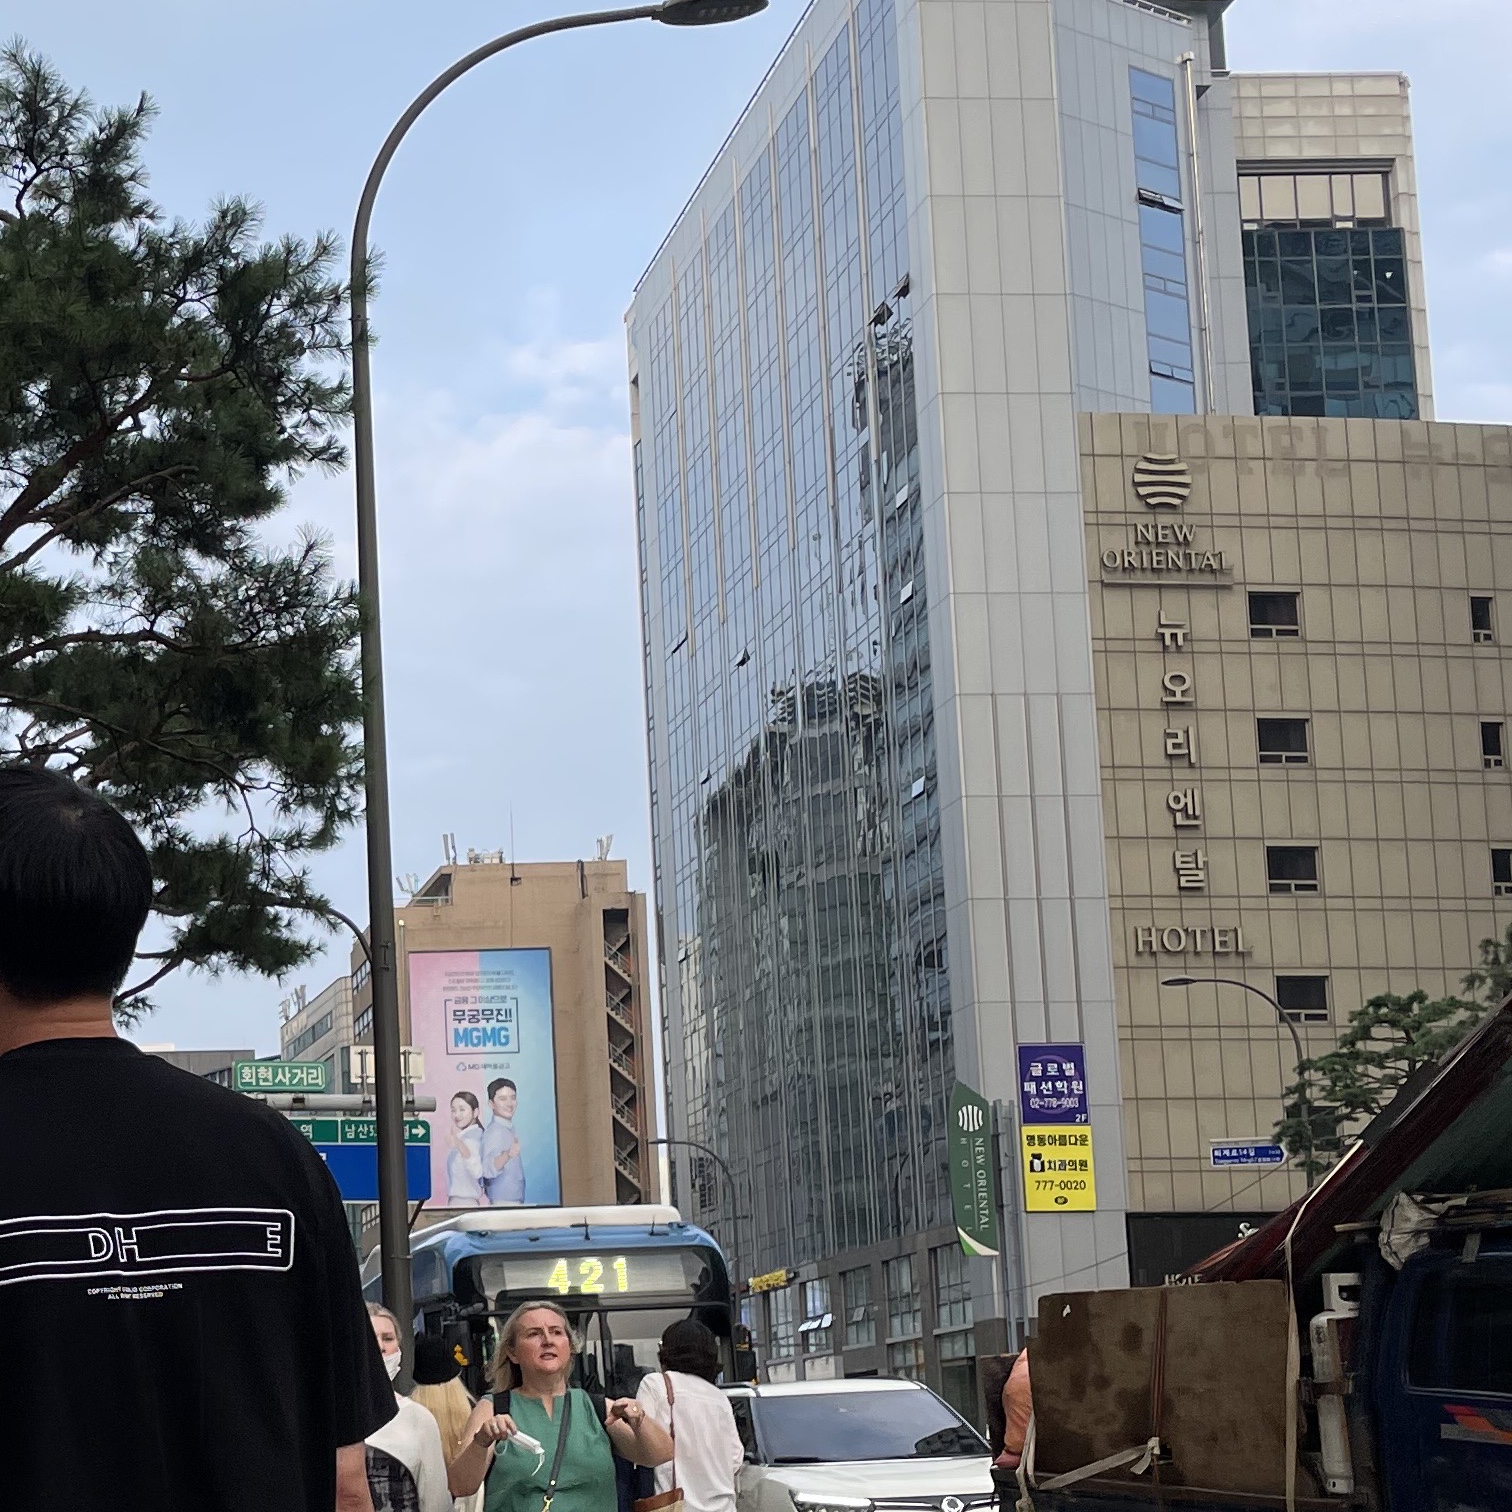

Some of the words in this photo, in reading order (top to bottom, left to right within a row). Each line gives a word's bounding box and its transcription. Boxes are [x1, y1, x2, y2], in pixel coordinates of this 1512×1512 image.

[1133, 523, 1197, 545] NEW
[1101, 549, 1233, 573] ORIENTAL
[1134, 925, 1254, 955] HOTEL
[452, 1008, 513, 1024] 무궁무진!
[453, 1026, 510, 1048] MGMG
[240, 1066, 323, 1086] 회현사거리
[1029, 1062, 1076, 1077] 글로벌
[1075, 1114, 1088, 1123] 2F
[975, 1137, 985, 1168] NEW
[1046, 1159, 1089, 1172] 치과의원
[960, 1137, 973, 1232] HOTEL
[1035, 1180, 1087, 1191] 777-0020
[976, 1170, 989, 1231] ORIENTAL
[548, 1256, 628, 1294] 421
